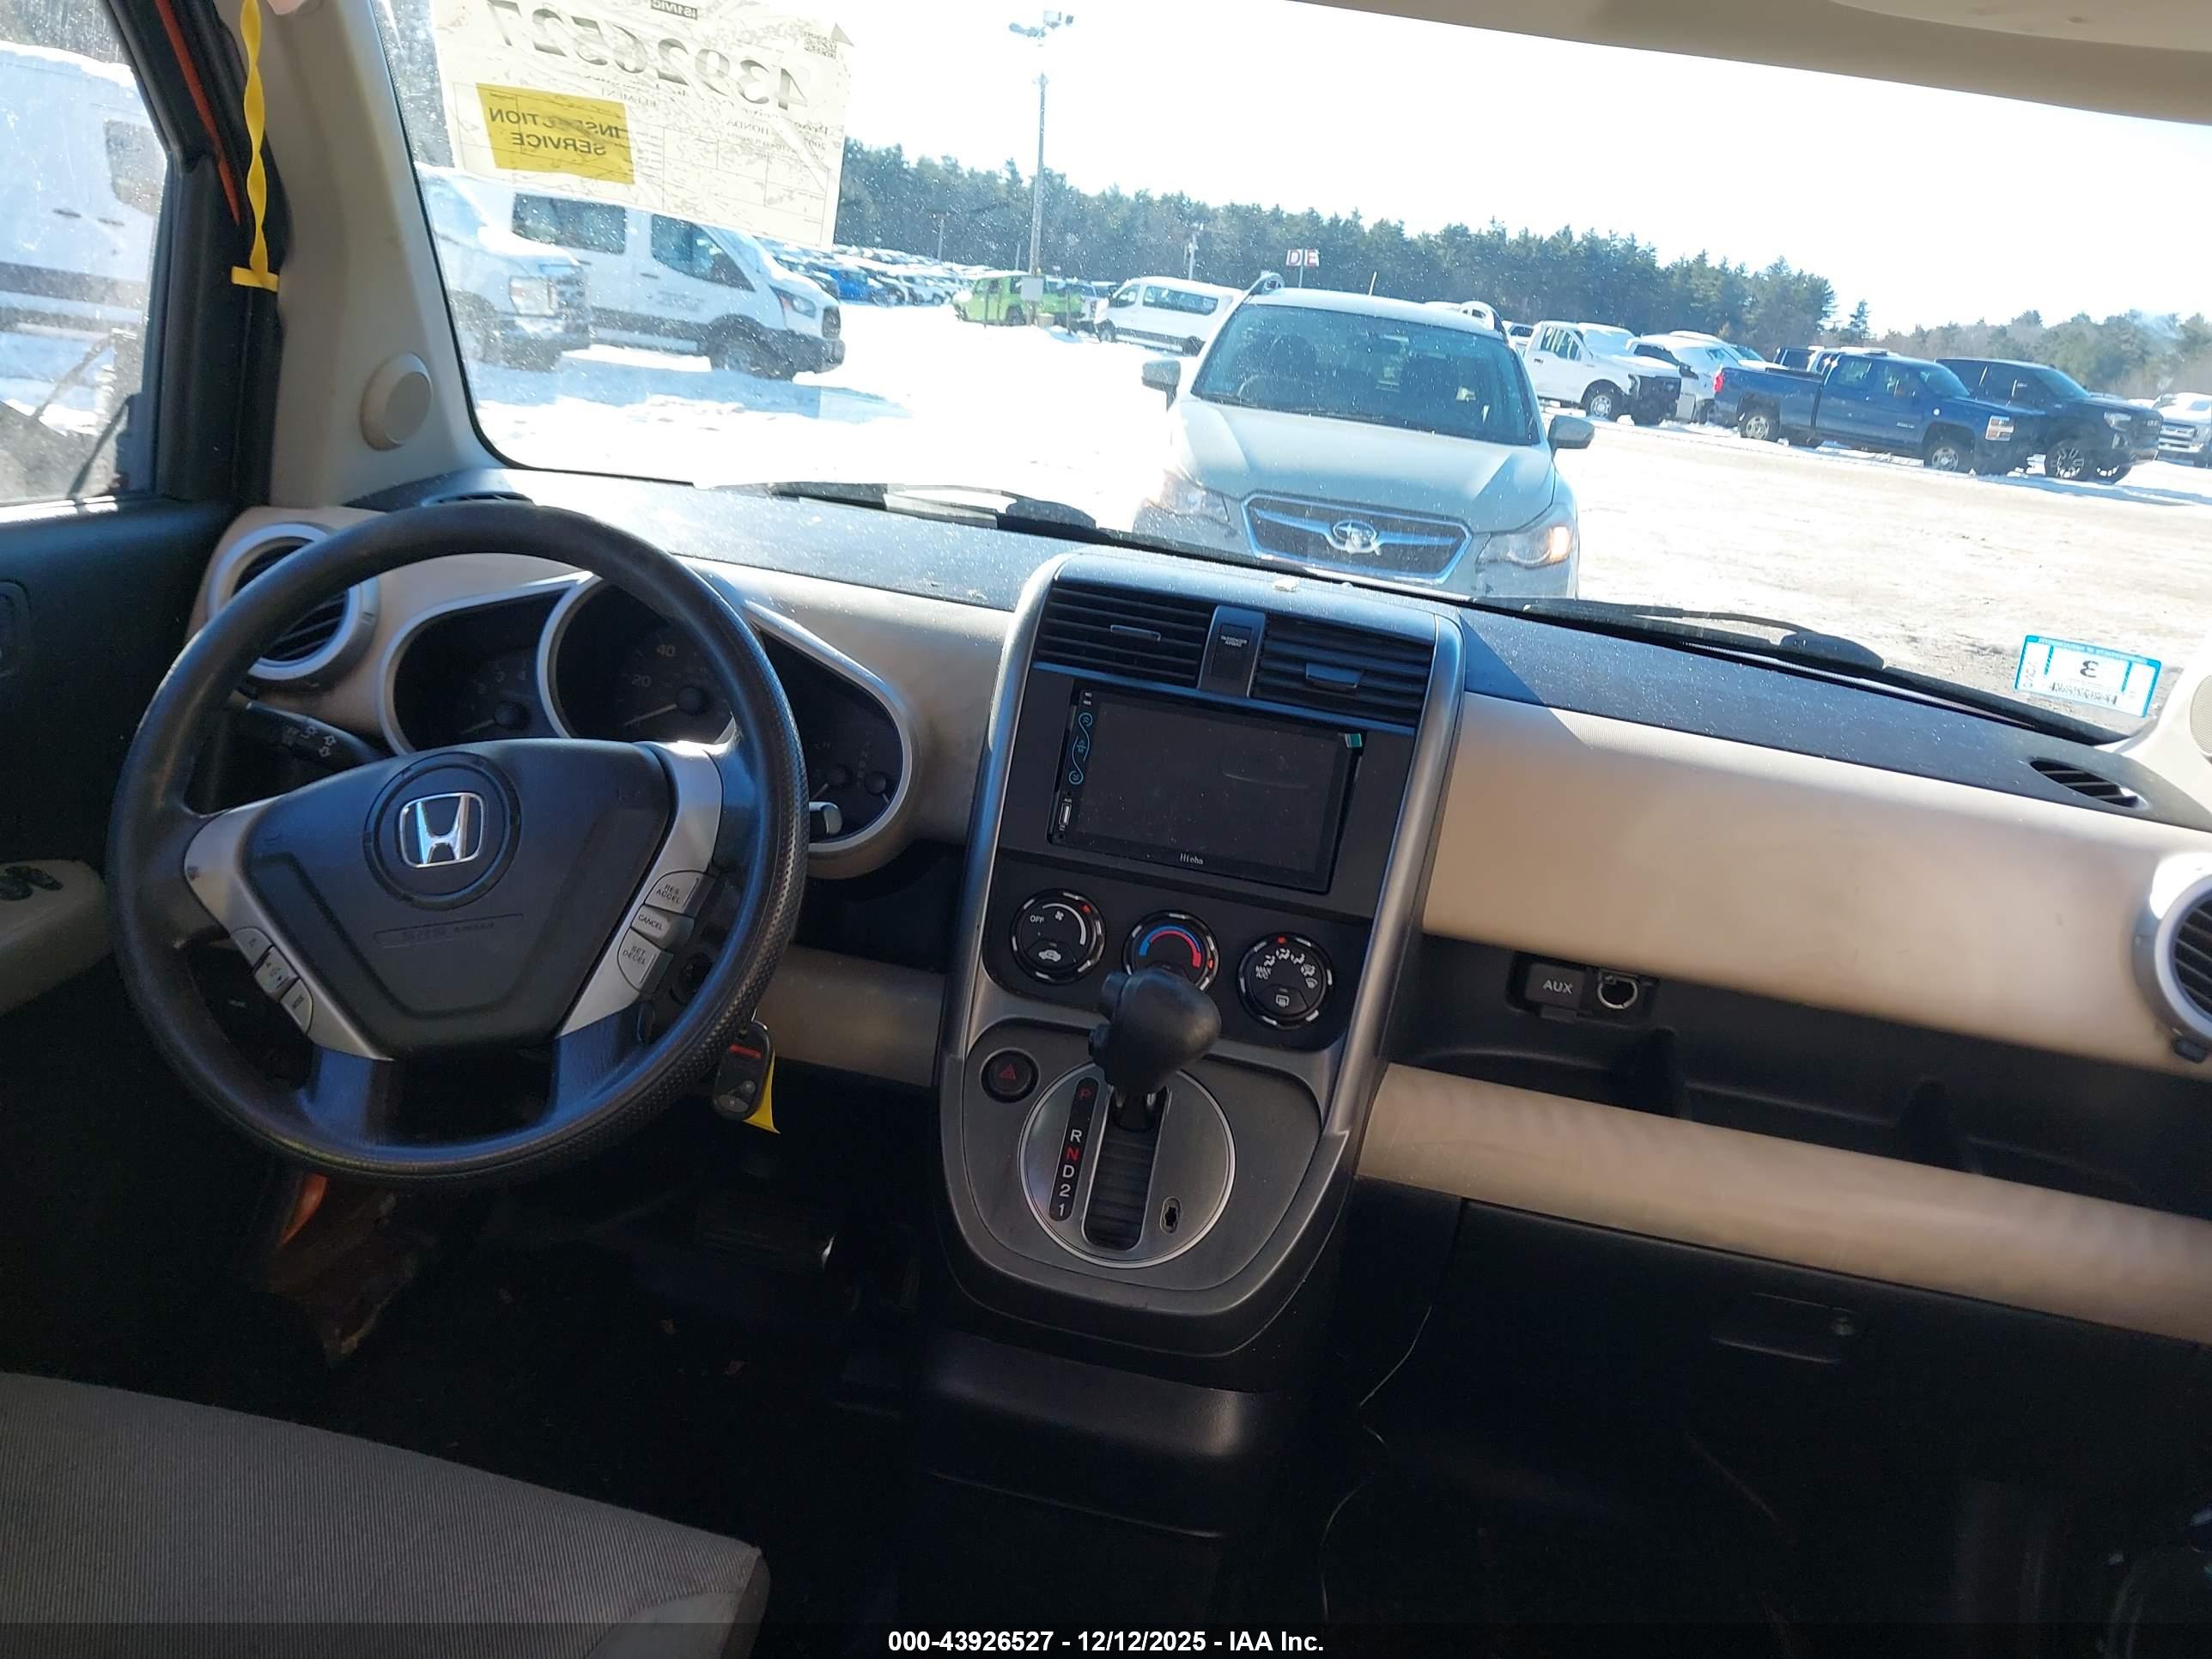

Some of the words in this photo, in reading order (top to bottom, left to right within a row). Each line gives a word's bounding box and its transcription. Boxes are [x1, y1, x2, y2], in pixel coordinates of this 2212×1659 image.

[656, 644, 676, 657] 40
[656, 889, 681, 903] ACCEL
[665, 884, 680, 895] RES
[638, 915, 663, 931] CANCEL
[1030, 915, 1045, 924] OFF
[623, 950, 646, 964] DECEL
[1543, 979, 1574, 995] AUX
[1070, 1129, 1083, 1143] R
[1066, 1146, 1080, 1161] N
[1062, 1164, 1075, 1178] D
[1059, 1183, 1072, 1198] 2
[1059, 1203, 1066, 1217] 1
